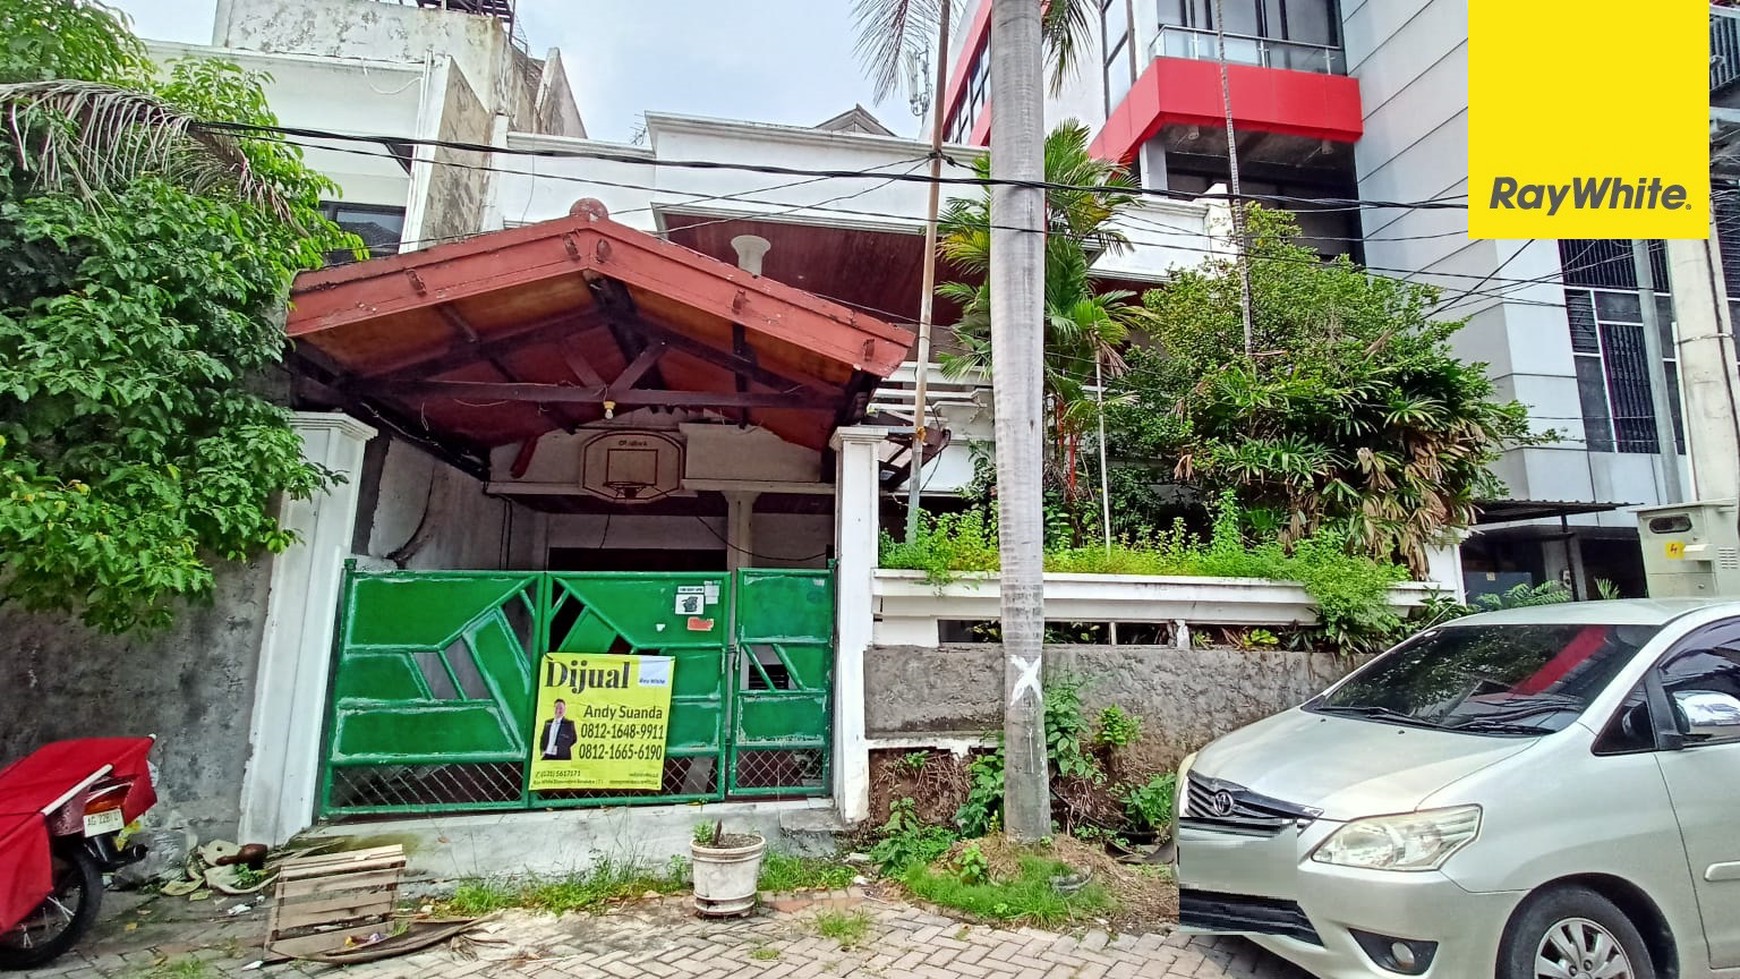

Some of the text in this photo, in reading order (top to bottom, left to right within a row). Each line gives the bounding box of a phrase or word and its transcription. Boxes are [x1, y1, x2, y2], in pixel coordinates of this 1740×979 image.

[544, 659, 631, 695] Dijual
[583, 704, 663, 721] Andy Suanda
[580, 722, 664, 740] 0812-1648-9911
[578, 743, 662, 761] 0812-1665-6190
